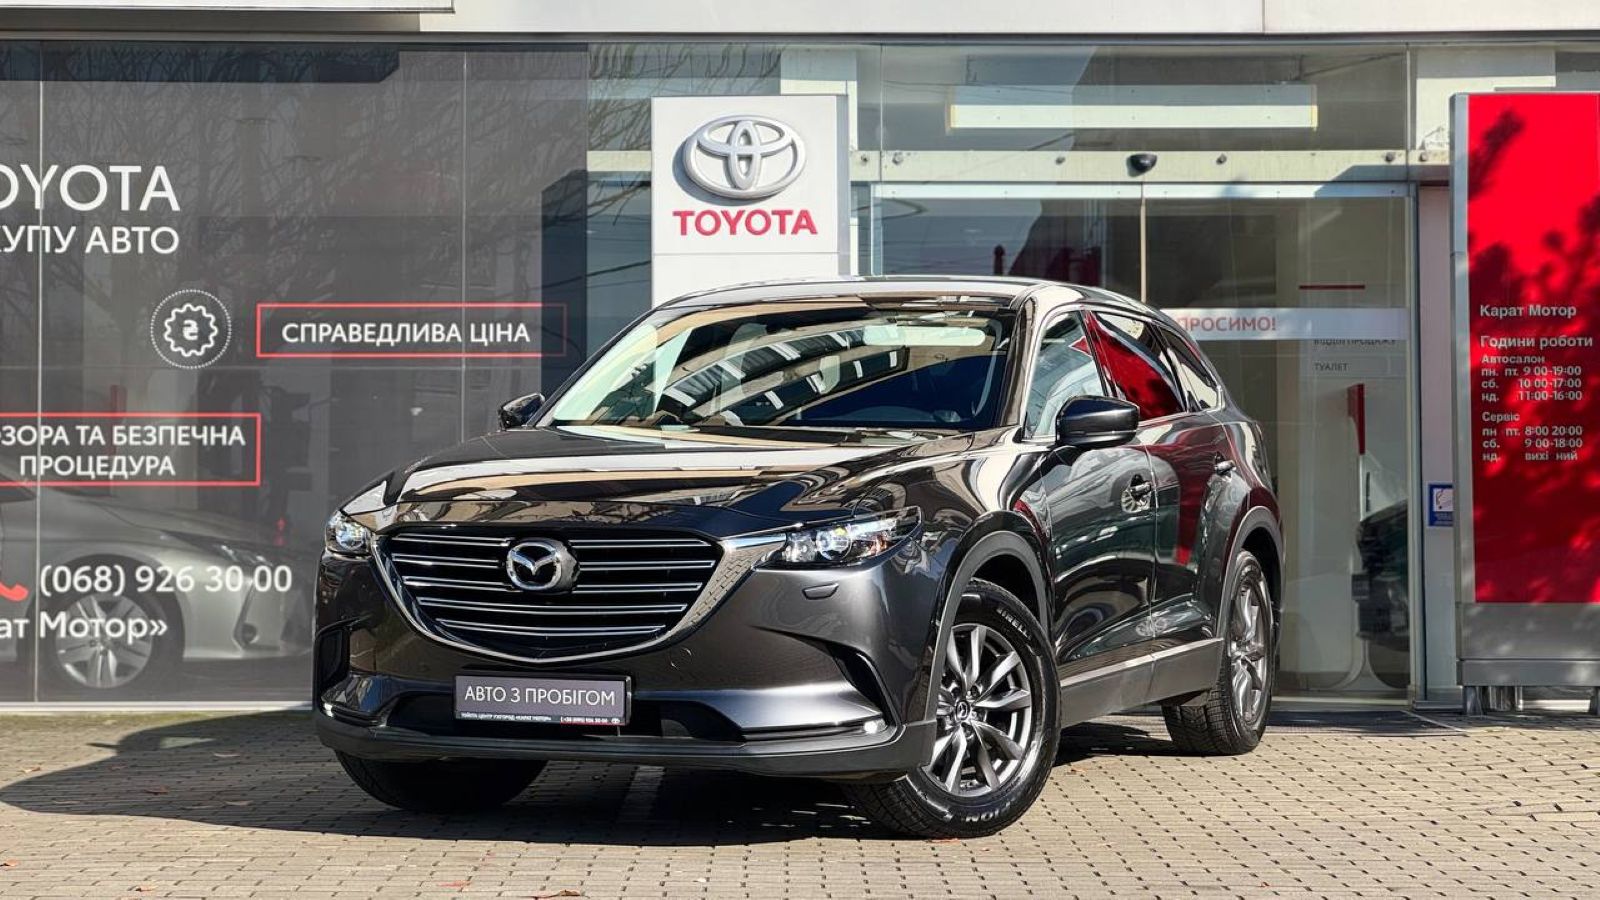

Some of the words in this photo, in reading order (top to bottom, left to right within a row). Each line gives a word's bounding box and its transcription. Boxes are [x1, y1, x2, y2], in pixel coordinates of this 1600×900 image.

[672, 209, 818, 236] TOYOTA
[0, 225, 77, 253] УПУ
[84, 226, 180, 254] АВТО
[1480, 304, 1524, 319] Карат
[1528, 304, 1577, 319] Мотор
[282, 322, 462, 346] СПРАВЕДЛИВА
[470, 322, 531, 346] ЦІНА
[1480, 335, 1536, 349] Години
[1539, 335, 1594, 350] роботи
[1481, 355, 1545, 364] Автосалон
[1482, 411, 1520, 423] Сервіс
[0, 425, 70, 446] ЗОРА
[75, 425, 106, 446] ТА
[112, 425, 246, 446] БЕЗПЕЧНА
[20, 455, 176, 480] ПРОЦЕДУРА
[40, 565, 125, 597] (068)
[135, 565, 195, 593] 926
[205, 565, 244, 593] 30
[254, 565, 292, 593] 00
[40, 611, 168, 645] Мотор»
[465, 685, 507, 703] АВТО
[510, 687, 521, 703] З
[525, 688, 615, 706] ПРОБІГОМ
